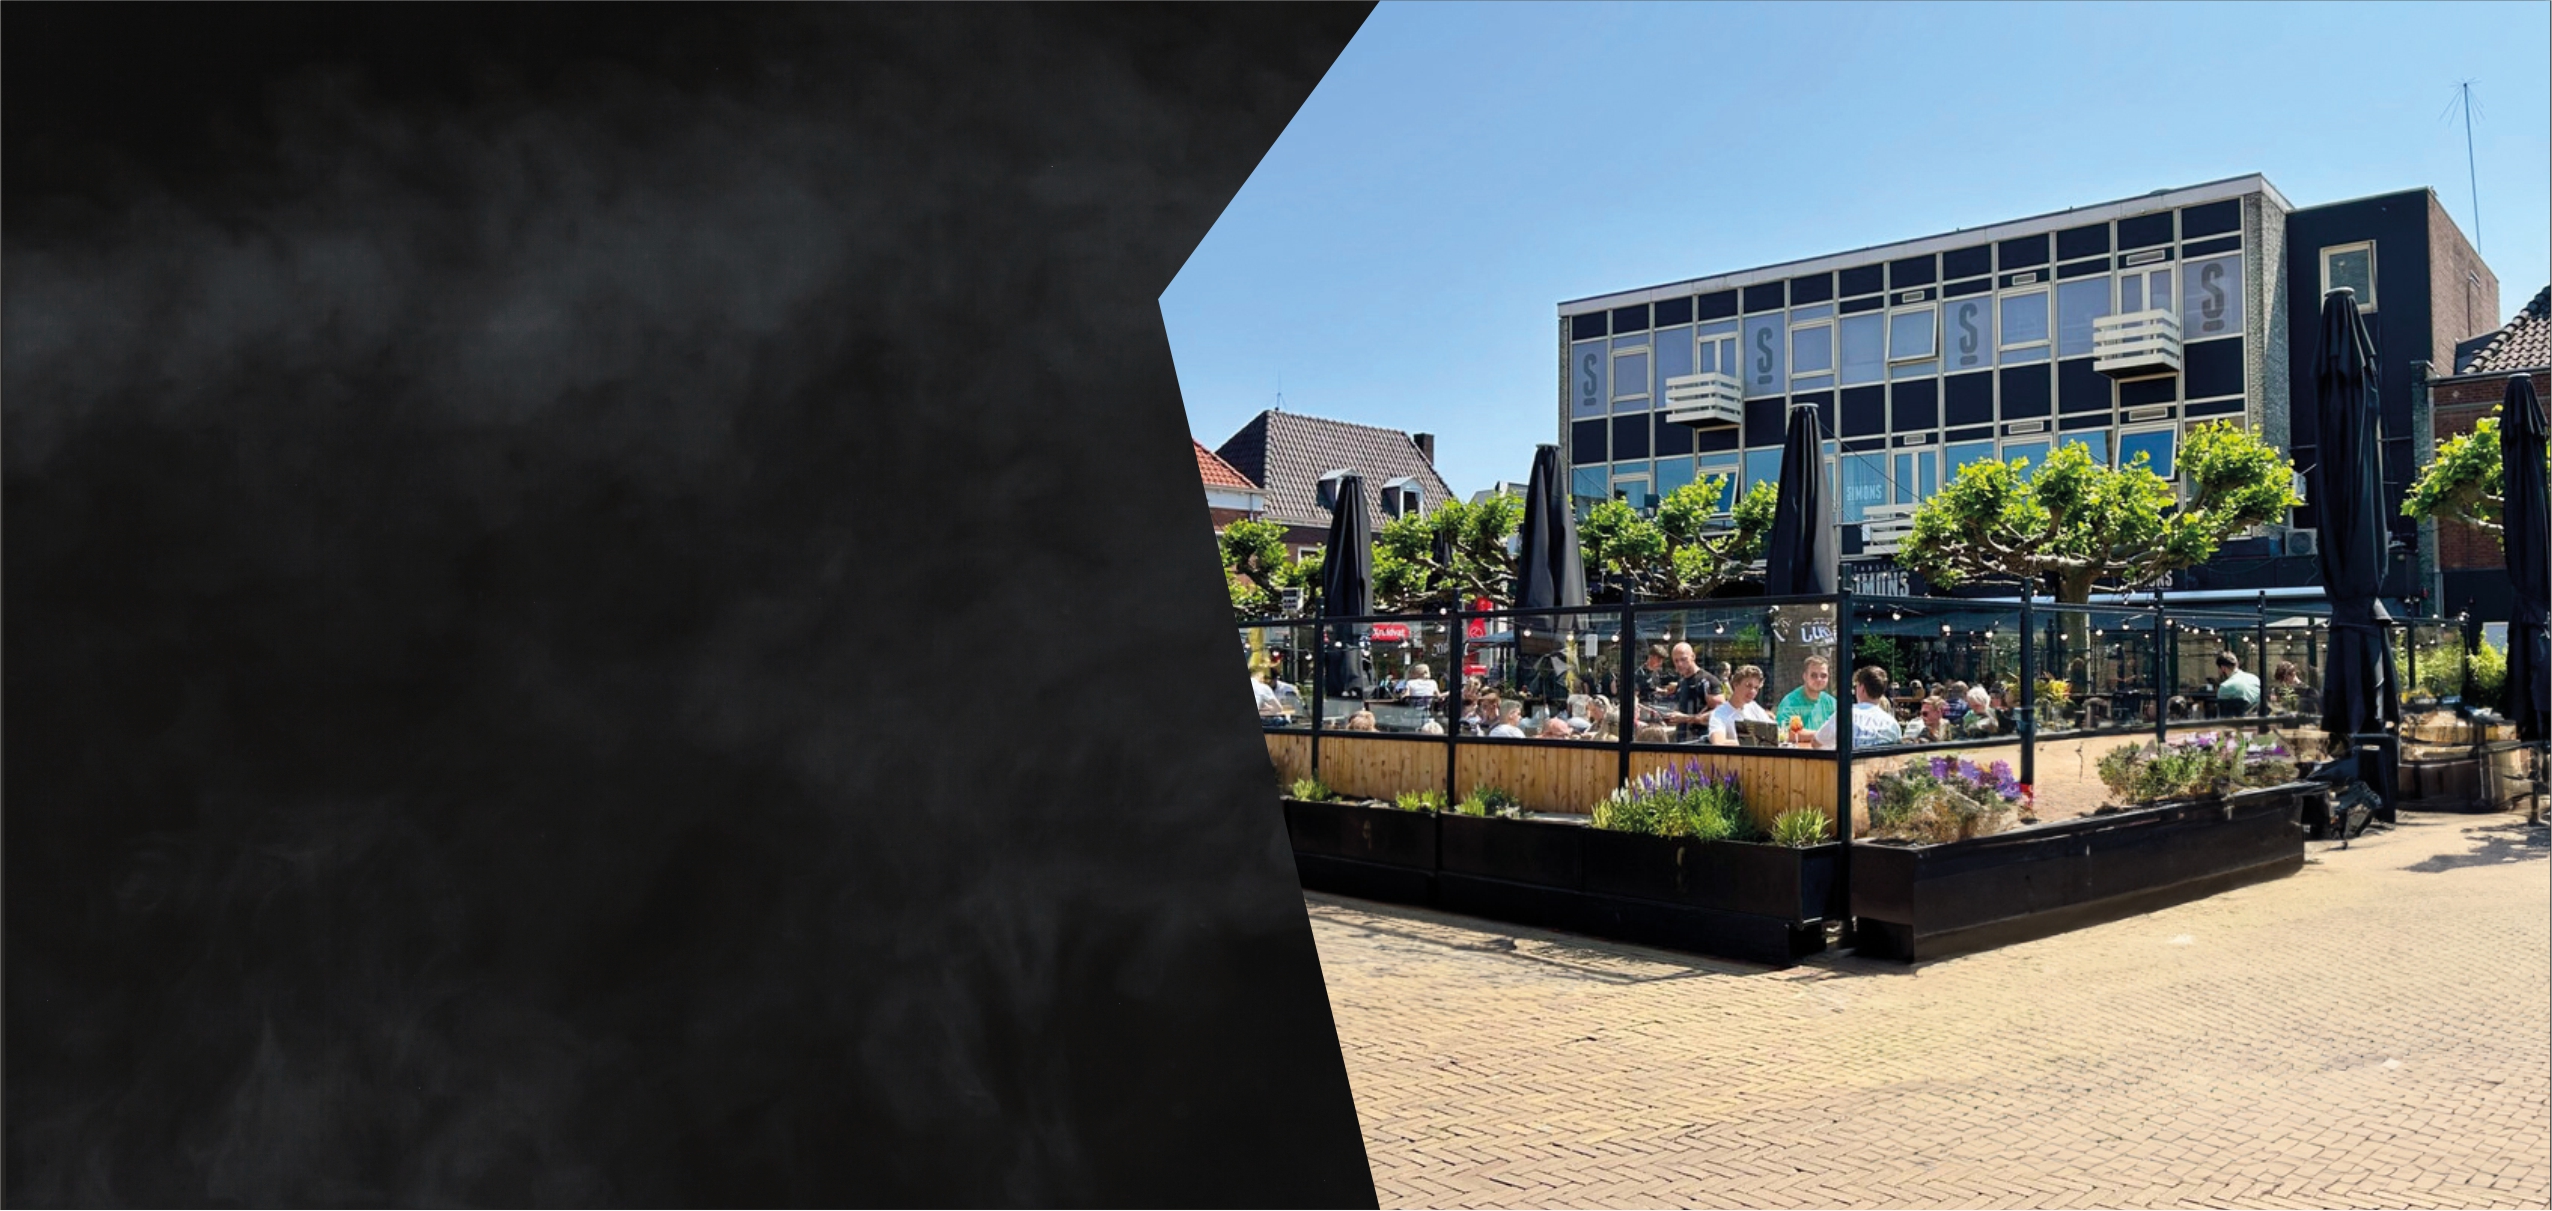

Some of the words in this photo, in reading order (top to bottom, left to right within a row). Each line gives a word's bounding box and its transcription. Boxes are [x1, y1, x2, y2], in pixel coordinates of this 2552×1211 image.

[2202, 263, 2224, 319] S
[1757, 327, 1773, 373] S
[1959, 303, 1978, 355] S
[1583, 353, 1597, 397] S
[1847, 484, 1882, 501] SIMONS
[1851, 571, 1910, 596] IMONS
